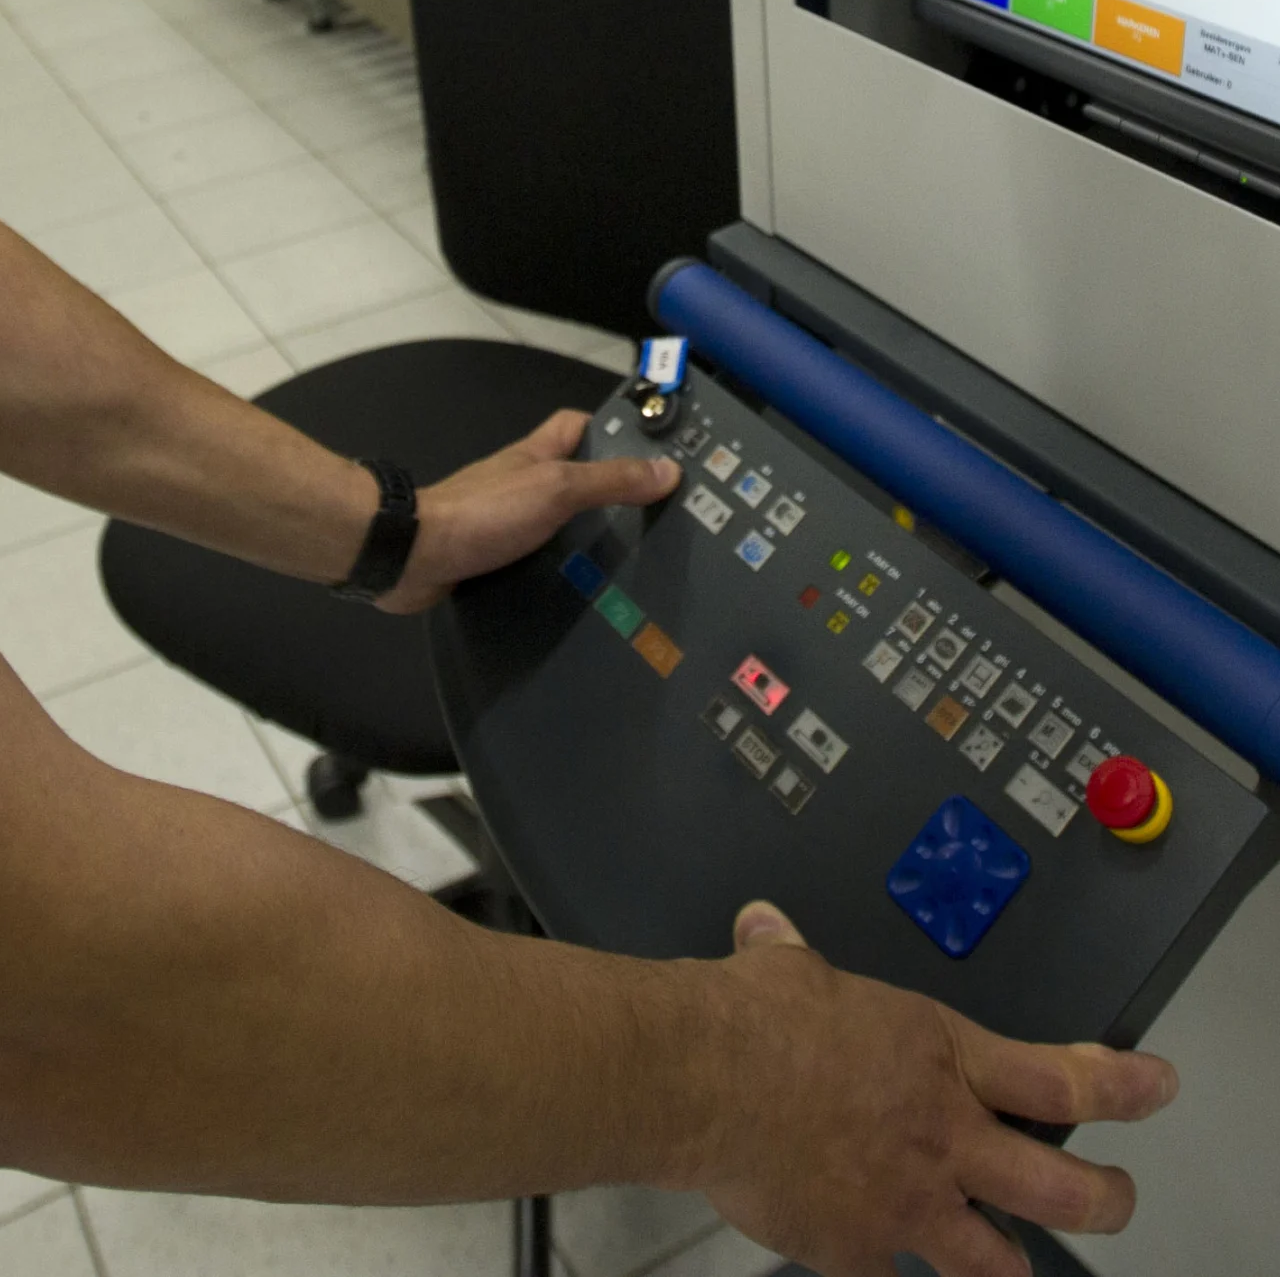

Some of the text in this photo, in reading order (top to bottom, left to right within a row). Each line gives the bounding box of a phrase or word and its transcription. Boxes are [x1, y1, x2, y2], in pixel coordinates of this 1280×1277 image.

[947, 613, 959, 625] 2
[980, 640, 992, 652] 3
[1015, 667, 1027, 679] 4
[1051, 696, 1064, 709] 5
[1088, 726, 1101, 739] 6
